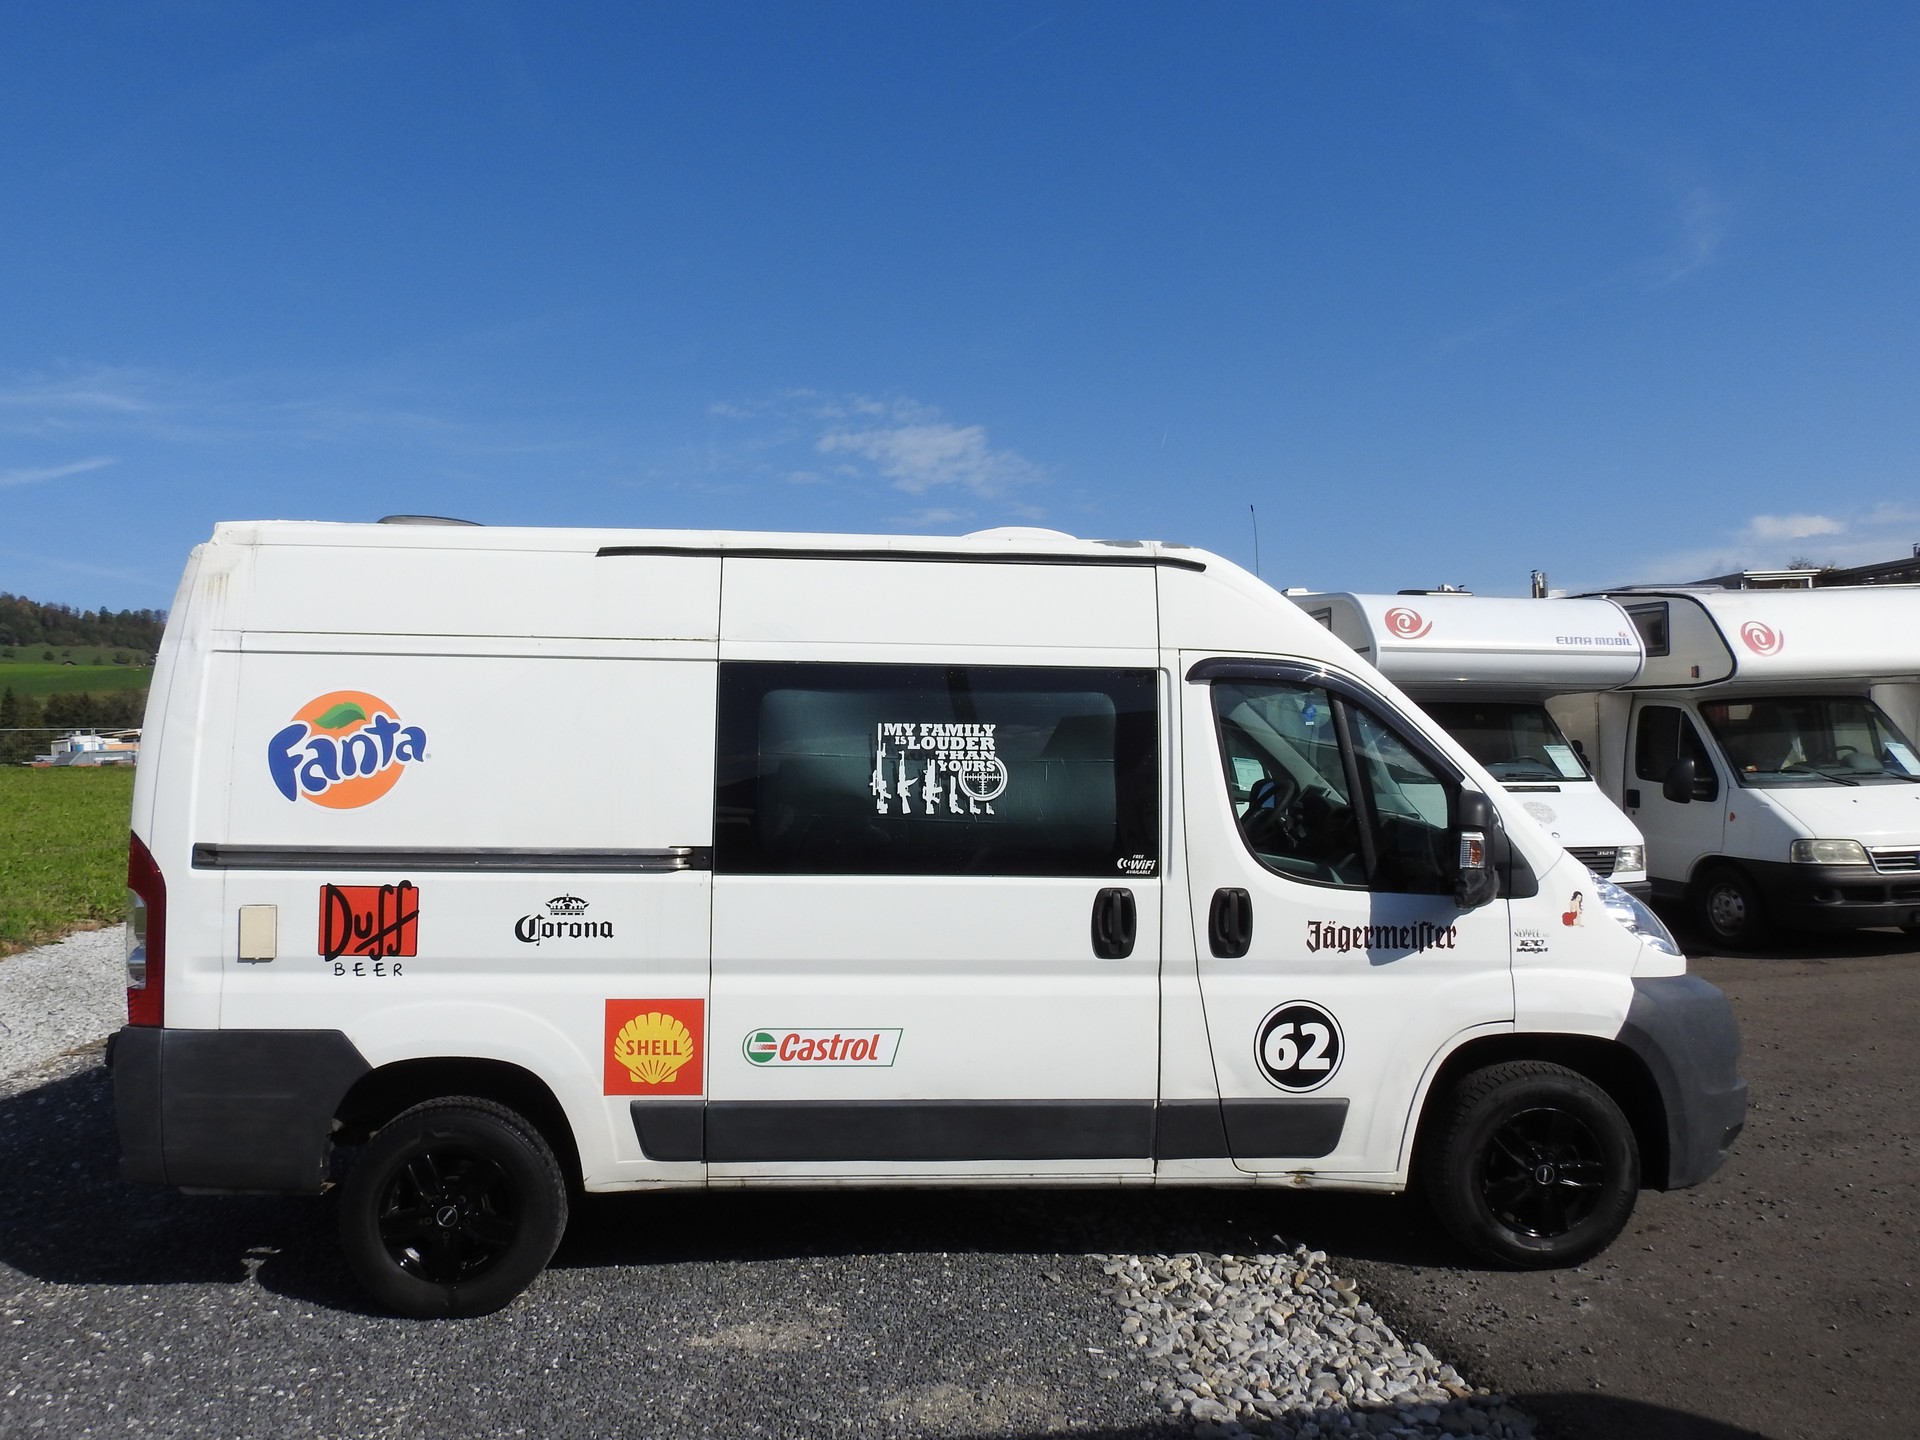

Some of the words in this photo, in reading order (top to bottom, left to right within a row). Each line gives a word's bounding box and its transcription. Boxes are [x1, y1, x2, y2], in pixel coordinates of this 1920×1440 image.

[1556, 636, 1592, 645] EURA
[1595, 637, 1632, 646] MOBIL
[884, 723, 916, 736] MY
[920, 723, 996, 737] FAMILY
[895, 736, 907, 745] IS
[908, 737, 996, 750] LOUDER
[268, 714, 427, 802] Fanta
[935, 751, 996, 760] THAN
[937, 760, 996, 772] YOURS
[325, 880, 419, 962] Duff
[515, 914, 614, 946] Corona
[333, 962, 403, 977] BEER
[626, 1039, 683, 1056] SHELL
[779, 1033, 881, 1061] Castrol
[1264, 1022, 1331, 1071] 62
